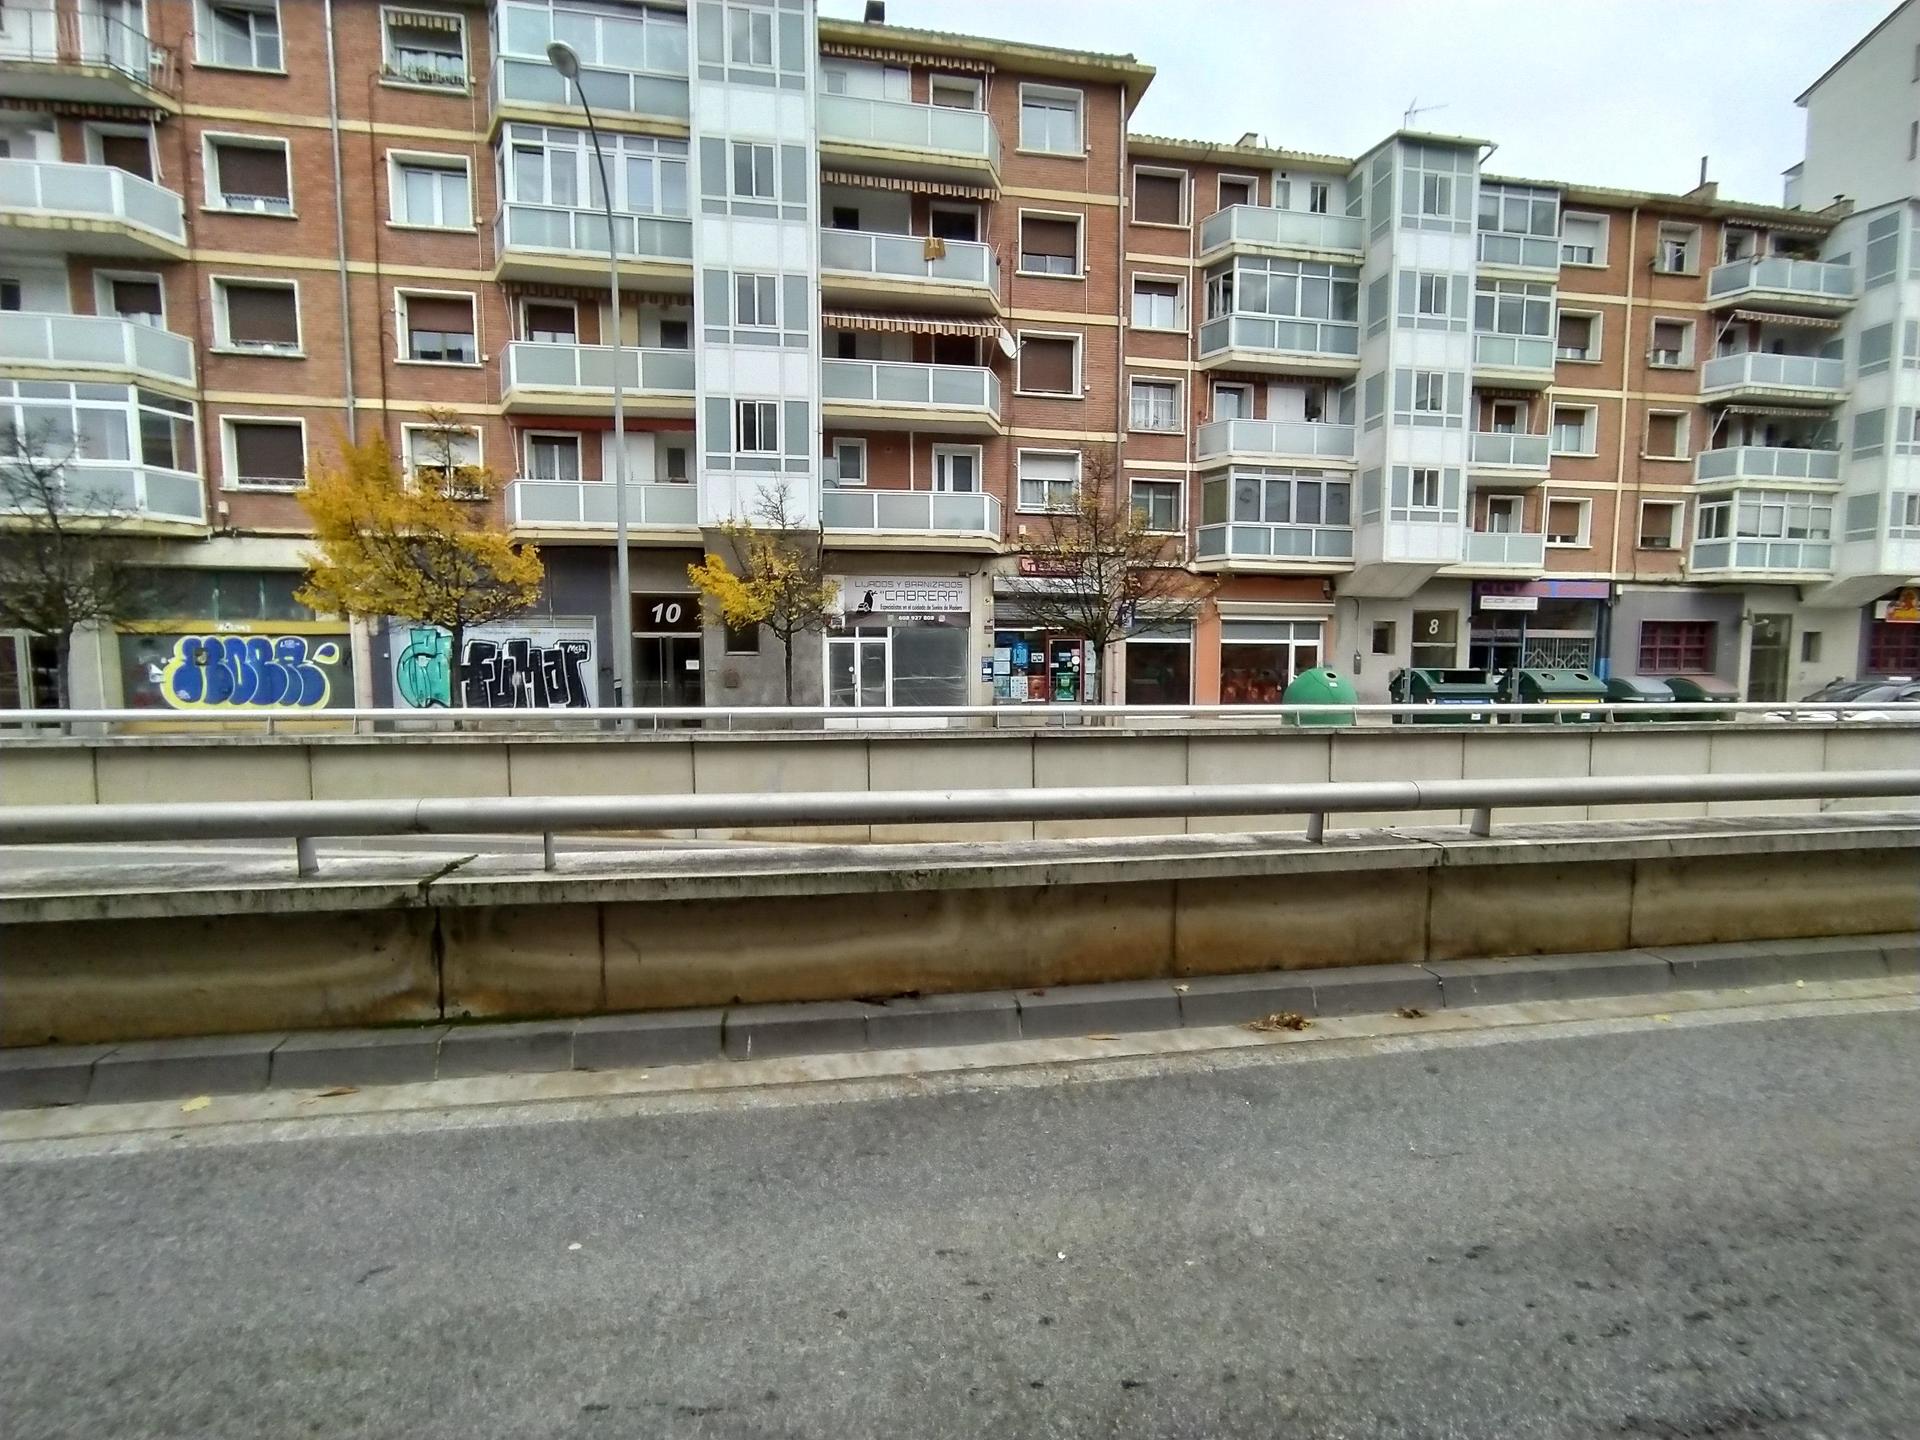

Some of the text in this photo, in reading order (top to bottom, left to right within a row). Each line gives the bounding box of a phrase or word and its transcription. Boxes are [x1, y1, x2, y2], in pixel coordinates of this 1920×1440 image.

[904, 580, 963, 589] BARNIZADOS
[651, 603, 682, 623] 10
[1429, 618, 1439, 635] 8
